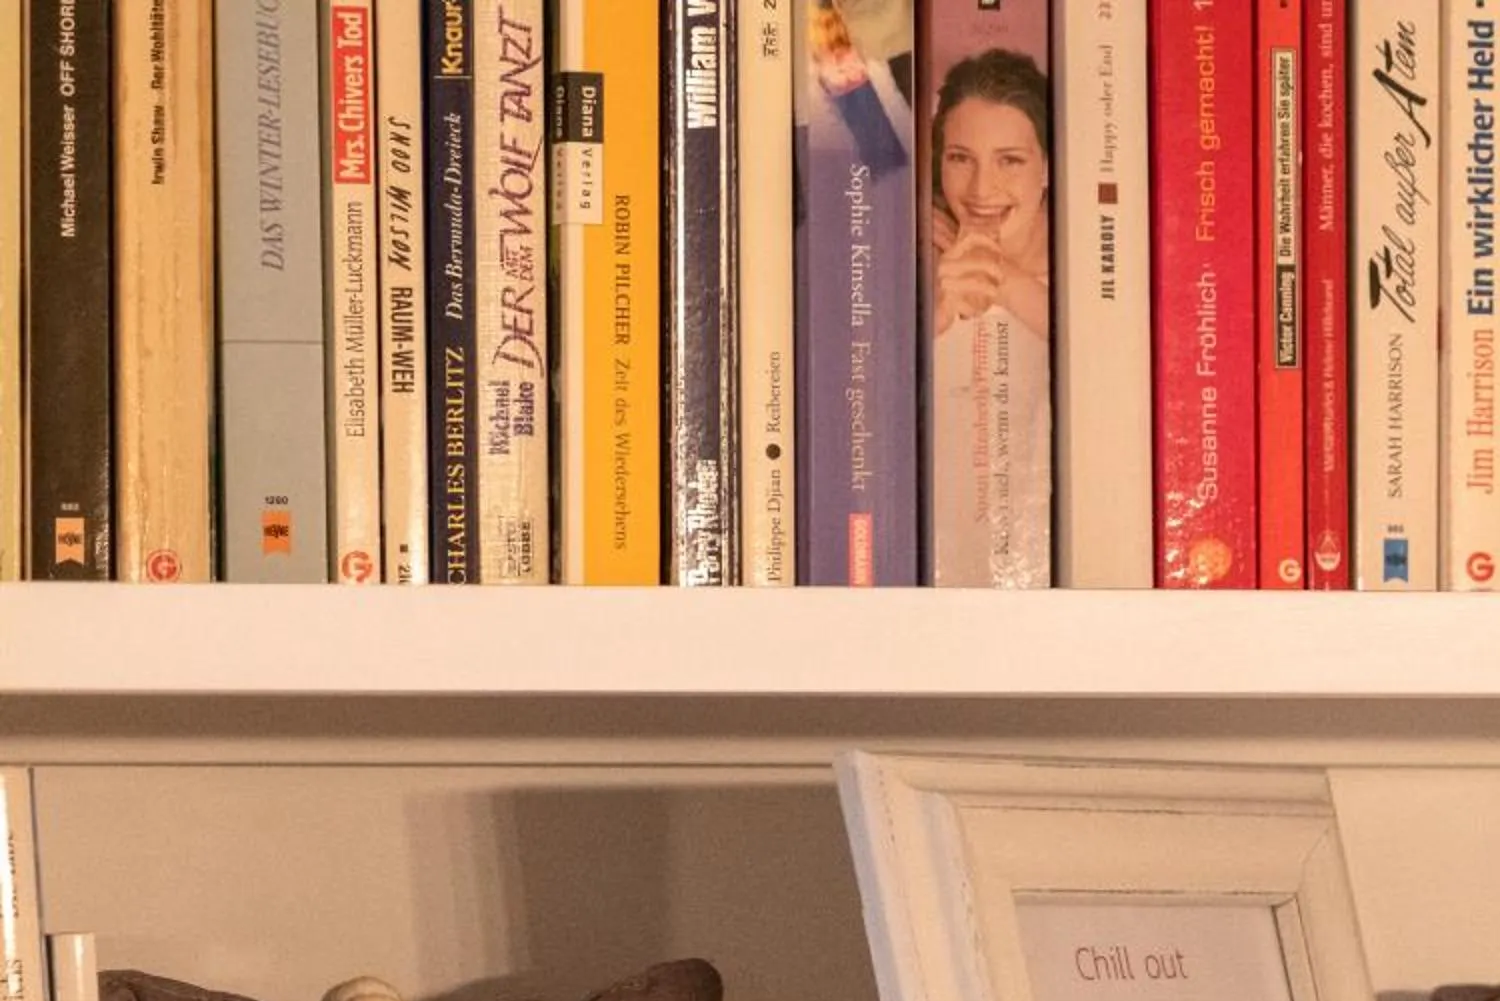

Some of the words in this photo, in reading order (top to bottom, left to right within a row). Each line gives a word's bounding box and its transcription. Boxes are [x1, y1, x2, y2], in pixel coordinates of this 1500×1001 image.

[334, 12, 364, 49] Tod
[1097, 44, 1115, 76] End
[1317, 23, 1334, 58] sind
[1466, 20, 1494, 90] Held
[61, 62, 75, 96] OFF
[334, 56, 365, 131] Chivers
[498, 5, 542, 126] TANZT
[687, 26, 718, 128] William
[1194, 26, 1222, 150] gemacht!
[1276, 57, 1294, 96] später
[1317, 63, 1336, 127] kochen,
[1372, 20, 1431, 148] Atem
[581, 87, 596, 137] Diana
[1098, 81, 1115, 117] oder
[1277, 99, 1291, 119] Sie
[61, 105, 76, 170] Weisser
[152, 149, 164, 185] Irwin
[336, 136, 366, 179] Mrs.
[1098, 121, 1118, 173] Happy
[1277, 122, 1292, 176] erfahren
[1318, 132, 1334, 158] die
[60, 173, 76, 237] Michael
[444, 112, 464, 277] Bermuda-Dreieck
[580, 149, 594, 210] Verlag
[848, 164, 871, 236] Sophie
[1195, 160, 1216, 241] Frisch
[1278, 180, 1292, 234] Wahrheit
[1318, 163, 1337, 231] Männer,
[1466, 98, 1495, 258] wirklicher
[261, 221, 285, 270] DAS
[389, 188, 412, 271] WILSON
[615, 195, 630, 255] ROBIN
[1100, 215, 1115, 274] KAROLY
[1279, 237, 1292, 257] Die
[343, 201, 365, 353] Müller-Luckmann
[444, 280, 463, 319] Das
[615, 263, 631, 345] PILCHER
[850, 244, 871, 326] Kinsella
[1101, 278, 1115, 300] JIL
[1278, 271, 1296, 321] Canning
[1369, 238, 1417, 323] Total
[1467, 269, 1494, 315] Ein
[391, 287, 414, 393] RAUM-WEH
[492, 287, 544, 378] DER
[1194, 272, 1218, 376] Fröhlich
[615, 358, 630, 391] Zeit
[850, 341, 871, 380] Fast
[1387, 333, 1404, 431] HARRISON
[1466, 328, 1494, 437] Harrison
[344, 358, 366, 438] Elisabeth
[446, 347, 465, 456] BERLITZ
[489, 380, 510, 455] Michael
[514, 382, 534, 436] Blake
[615, 398, 631, 426] des
[845, 388, 871, 491] geschenkt
[1198, 387, 1219, 500] Susanne
[1387, 437, 1404, 498] SARAH
[1467, 449, 1495, 494] Jim
[615, 432, 631, 550] Wiedersehens
[446, 464, 466, 585] CHARLES
[766, 517, 784, 582] Philippe
[1075, 947, 1136, 981] Chill
[1145, 951, 1188, 979] out
